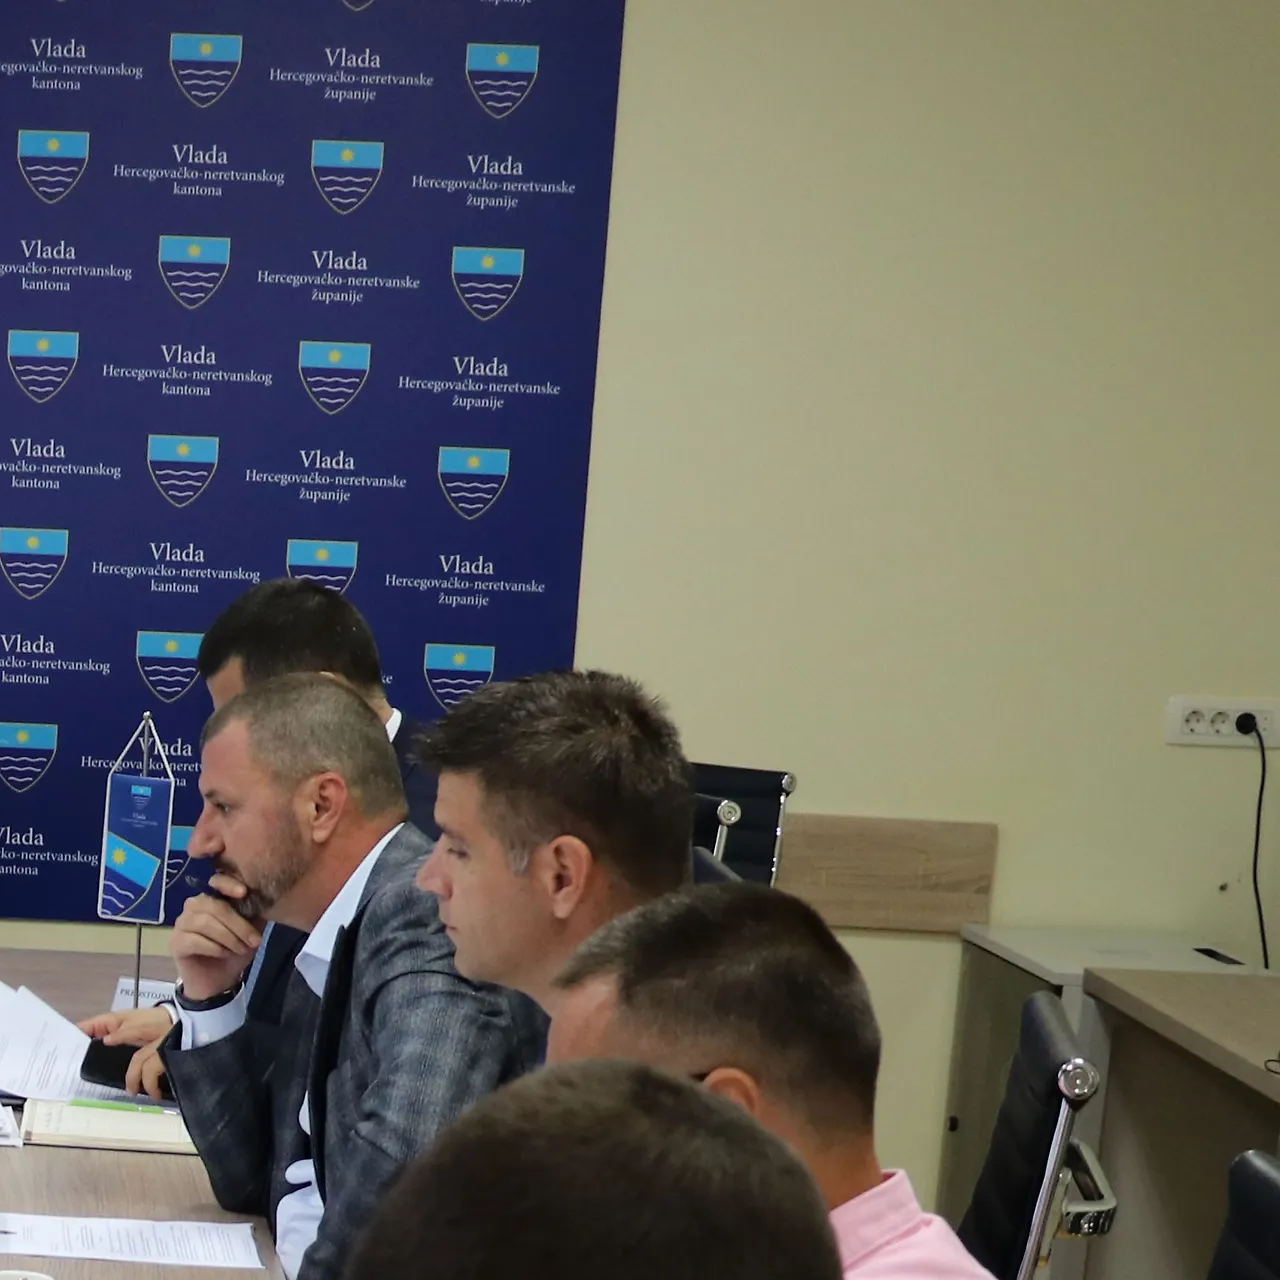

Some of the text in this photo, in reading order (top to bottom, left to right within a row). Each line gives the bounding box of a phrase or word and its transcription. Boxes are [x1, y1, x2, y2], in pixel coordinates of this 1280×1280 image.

[31, 38, 86, 58] Vlada
[325, 48, 380, 68] Vlada
[32, 76, 80, 90] kantona
[270, 68, 433, 86] Hercegovačko-neretvanske
[325, 88, 376, 102] županije
[172, 144, 227, 164] Vlada
[468, 155, 522, 175] Vlada
[114, 164, 284, 186] Hercegovačko-neretvanskog
[174, 182, 222, 196] kantona
[412, 176, 575, 193] Hercegovačko-neretvanske
[467, 194, 518, 210] županije
[21, 240, 75, 259] Vlada
[312, 250, 367, 270] Vlada
[22, 278, 70, 290] kantona
[258, 270, 420, 288] Hercegovačko-neretvanske
[312, 289, 363, 305] županije
[161, 344, 216, 364] Vlada
[104, 364, 272, 386] Hercegovačko-neretvanskog
[453, 356, 508, 376] Vlada
[162, 382, 210, 395] kantona
[399, 376, 560, 394] Hercegovačko-neretvanske
[452, 396, 504, 410] županije
[10, 438, 65, 458] Vlada
[300, 450, 354, 470] Vlada
[12, 476, 59, 488] kantona
[246, 470, 406, 487] Hercegovačko-neretvanske
[300, 488, 350, 503] županije
[150, 542, 204, 562] Vlada
[93, 562, 260, 583] Hercegovačko-neretvanskog
[440, 555, 493, 574] Vlada
[151, 580, 198, 592] kantona
[386, 574, 544, 592] Hercegovačko-neretvanske
[439, 593, 488, 608] županije
[0, 634, 54, 654] Vlada
[2, 671, 48, 684] kantona
